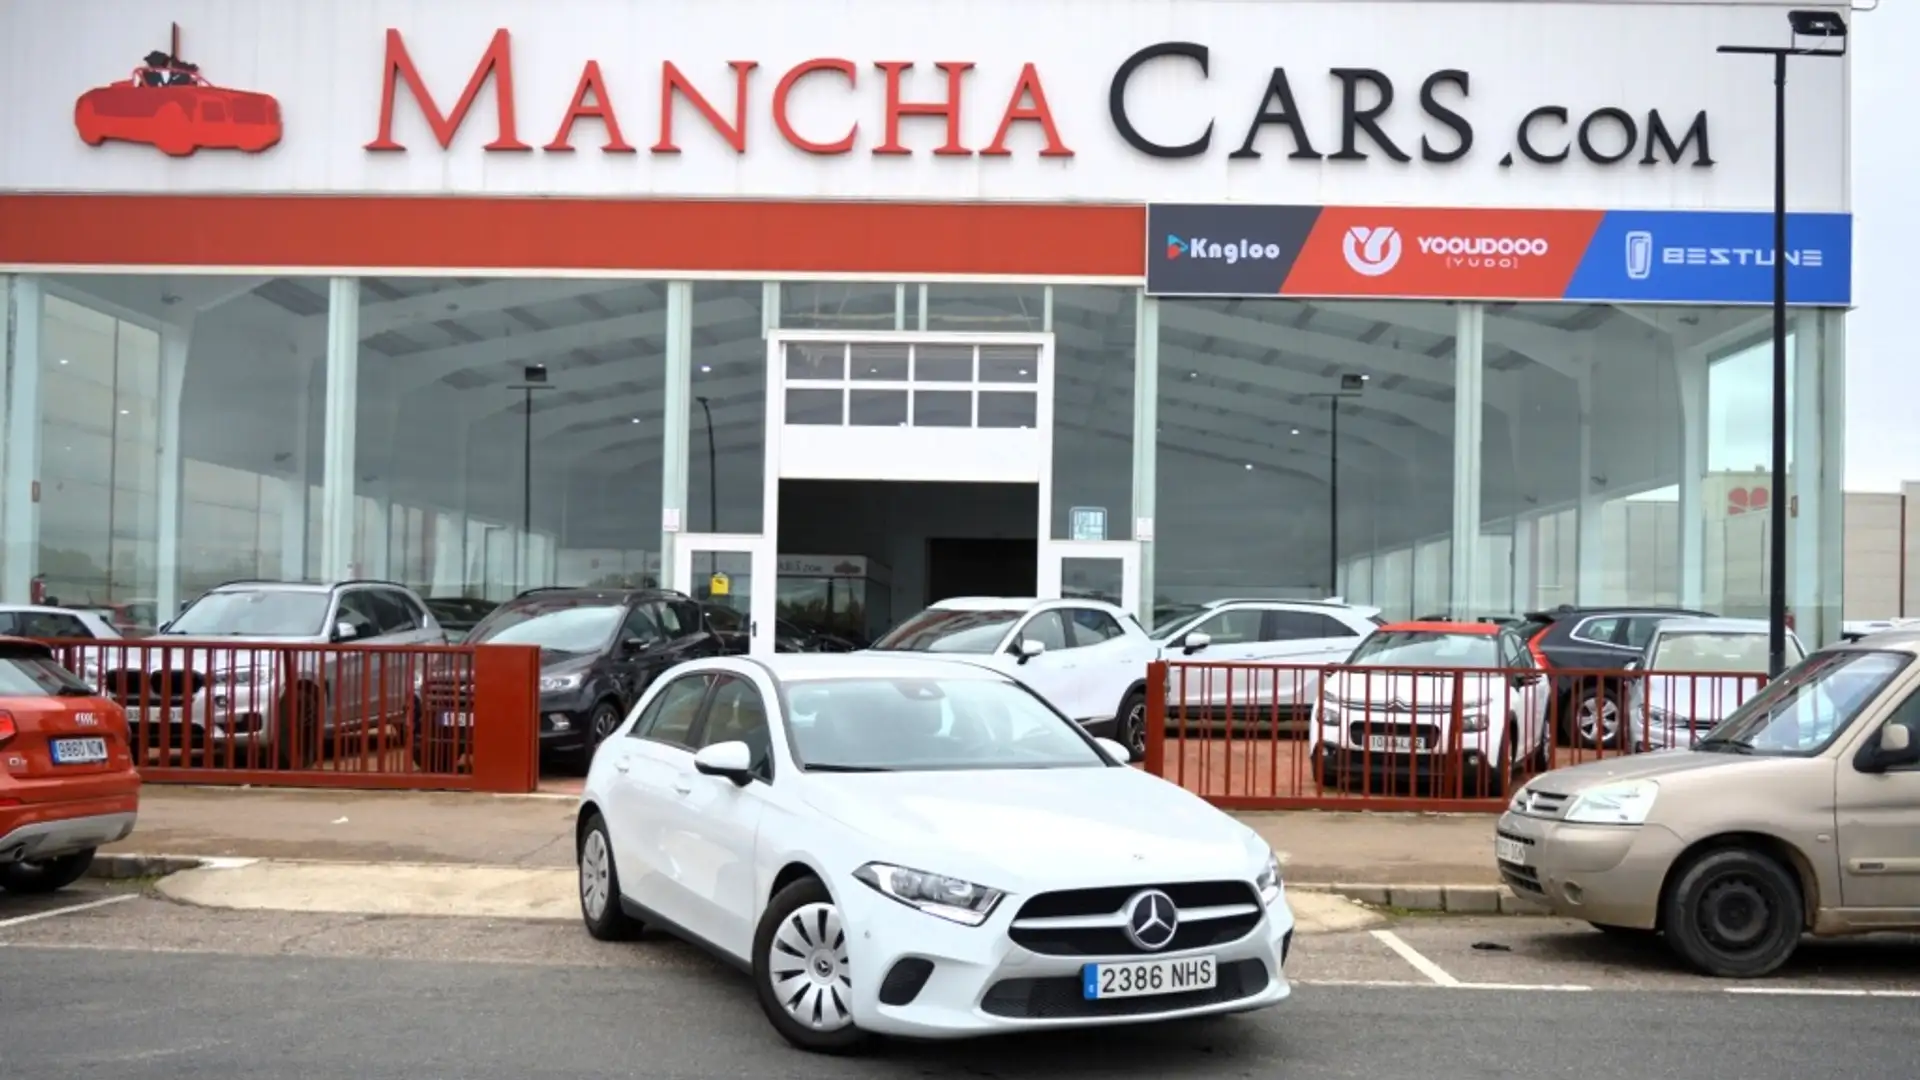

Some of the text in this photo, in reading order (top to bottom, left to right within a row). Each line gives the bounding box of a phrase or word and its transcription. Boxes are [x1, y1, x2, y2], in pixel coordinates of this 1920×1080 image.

[1190, 238, 1281, 264] Kngloo
[1417, 236, 1549, 256] YOOUDOOO
[1662, 247, 1823, 267] BESTUNE
[1102, 960, 1211, 993] 2386 NHS
